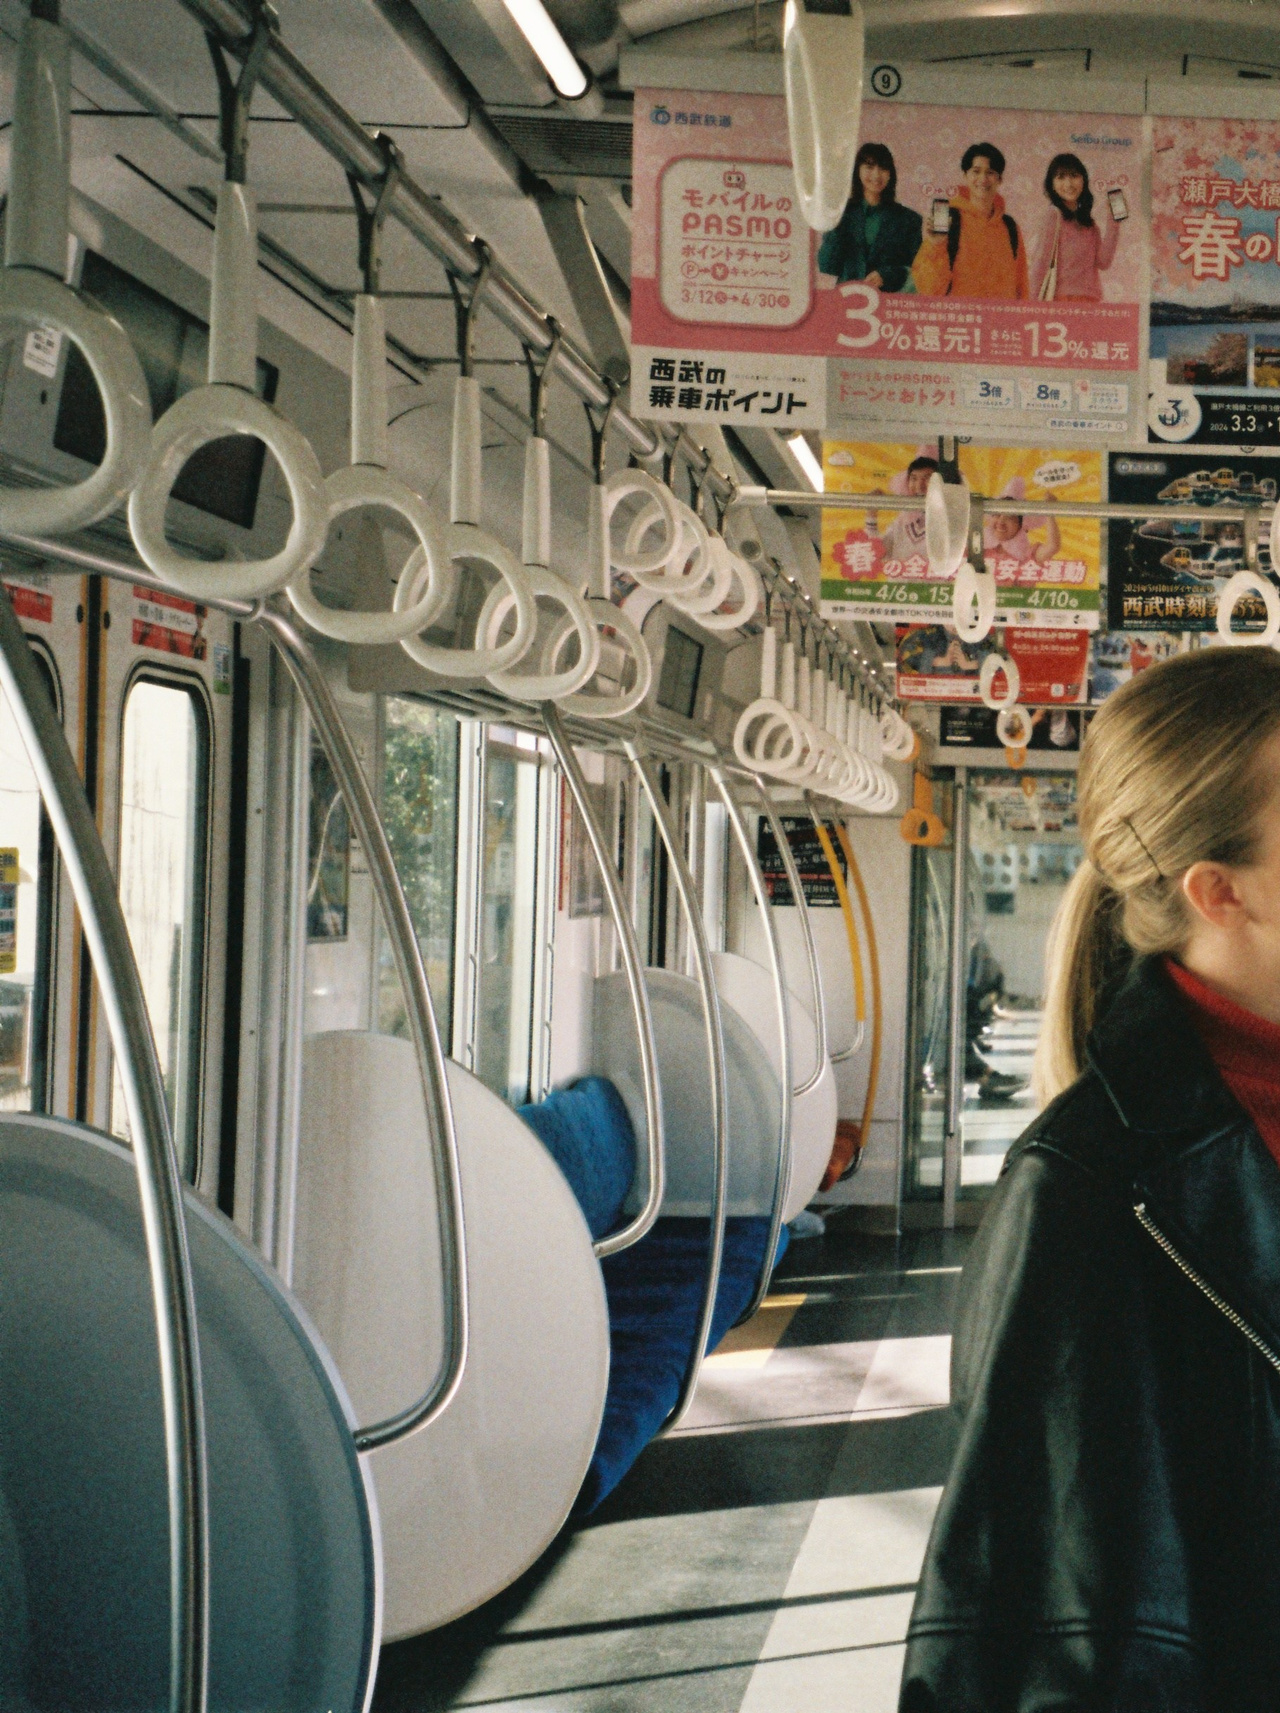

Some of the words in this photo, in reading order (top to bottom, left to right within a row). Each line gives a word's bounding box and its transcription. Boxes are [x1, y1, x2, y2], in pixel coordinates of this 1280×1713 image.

[682, 189, 793, 213] モバイルの
[682, 212, 792, 239] PASMO
[682, 245, 791, 264] ポイントチャージ
[650, 358, 726, 385] 西武の
[979, 381, 1002, 398] 3倍
[1036, 384, 1060, 401] 8倍
[649, 386, 807, 415] 乗車ポイント
[1231, 414, 1257, 432] 3.3
